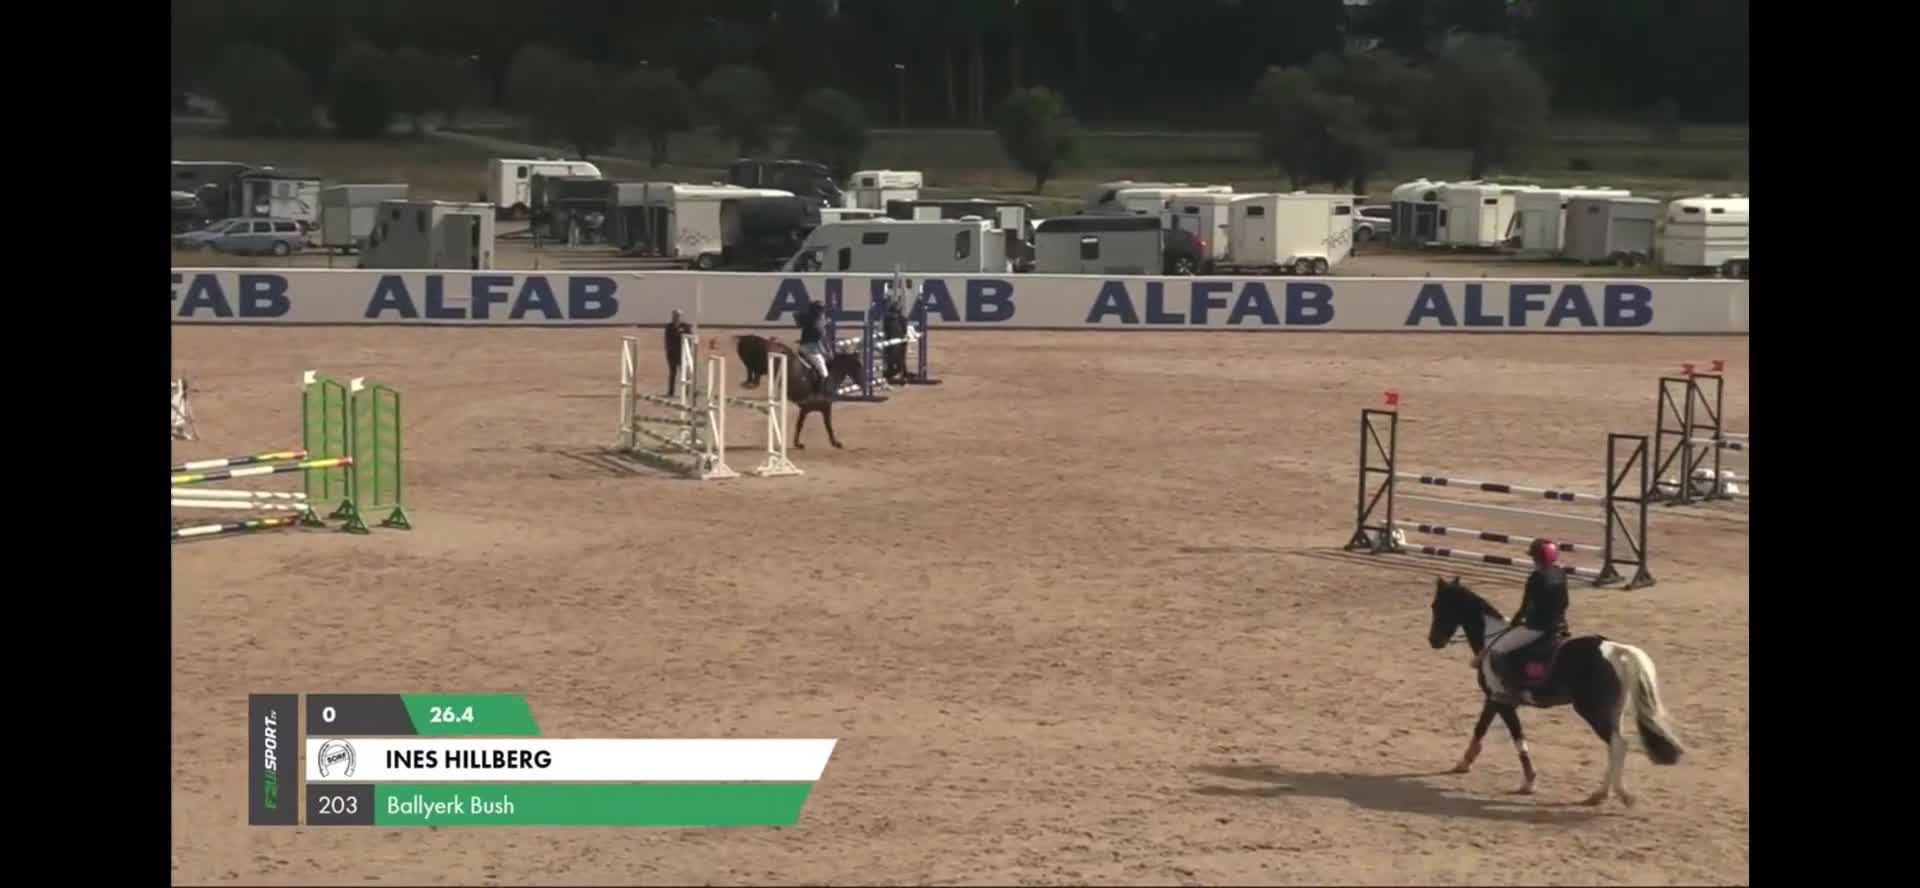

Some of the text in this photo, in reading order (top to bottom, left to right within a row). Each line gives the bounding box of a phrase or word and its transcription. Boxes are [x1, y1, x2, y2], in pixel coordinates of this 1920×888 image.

[171, 273, 291, 318] AB
[363, 274, 619, 320] ALFAB
[1085, 280, 1335, 326] ALFAB
[1403, 283, 1654, 328] ALFAB
